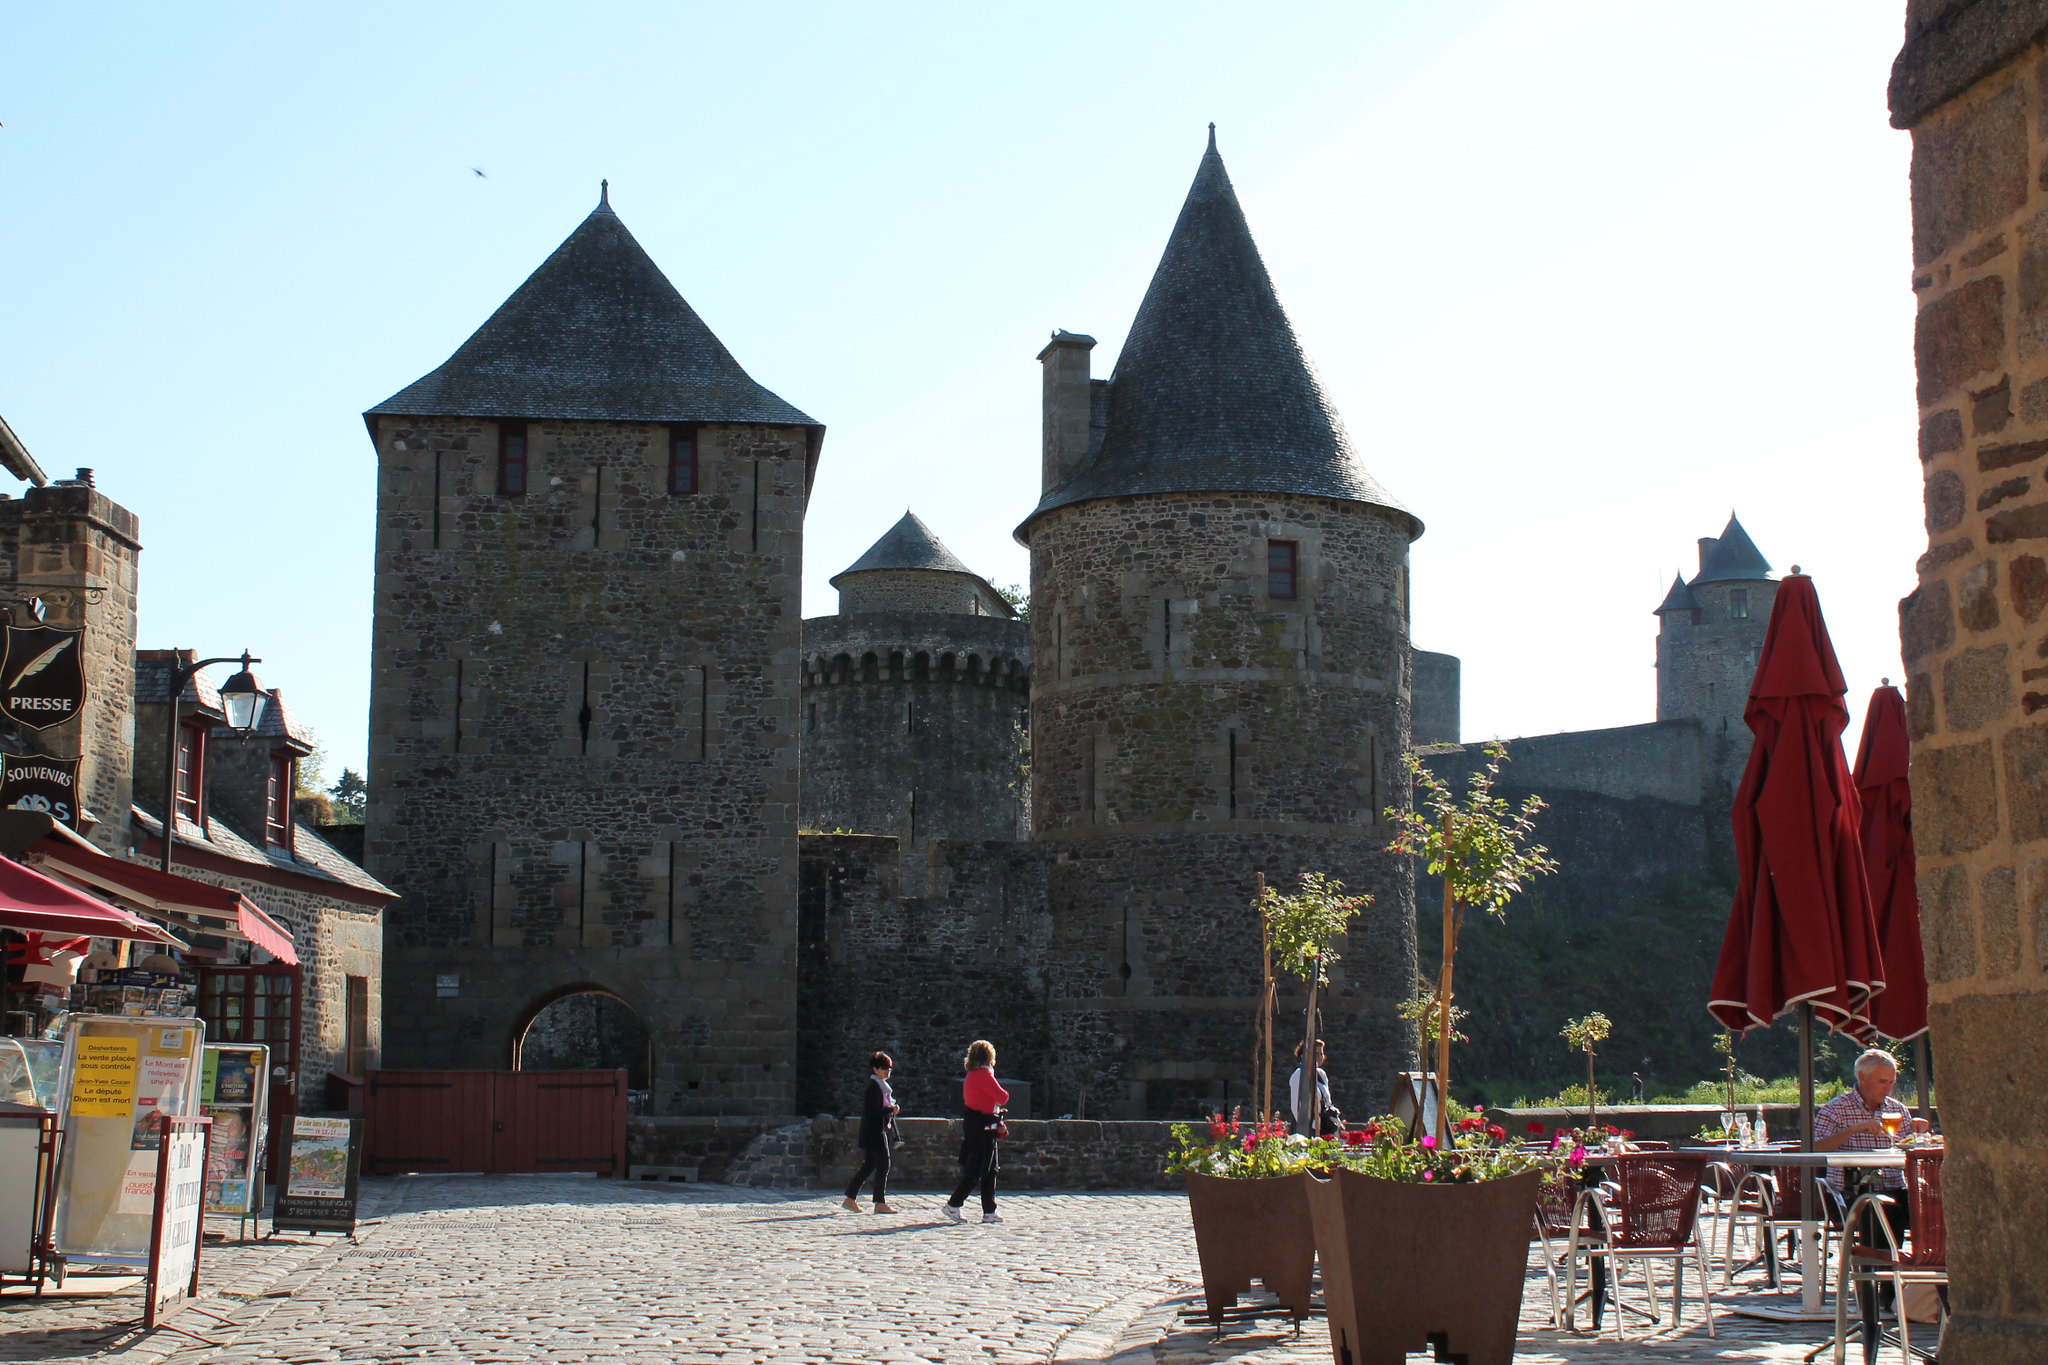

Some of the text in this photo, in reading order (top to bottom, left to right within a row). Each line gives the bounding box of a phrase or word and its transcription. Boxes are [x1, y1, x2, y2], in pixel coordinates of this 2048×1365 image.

[10, 697, 72, 712] PRESSE
[7, 767, 73, 787] SOUVENIRS
[128, 1181, 154, 1189] ouest
[125, 1187, 152, 1196] france
